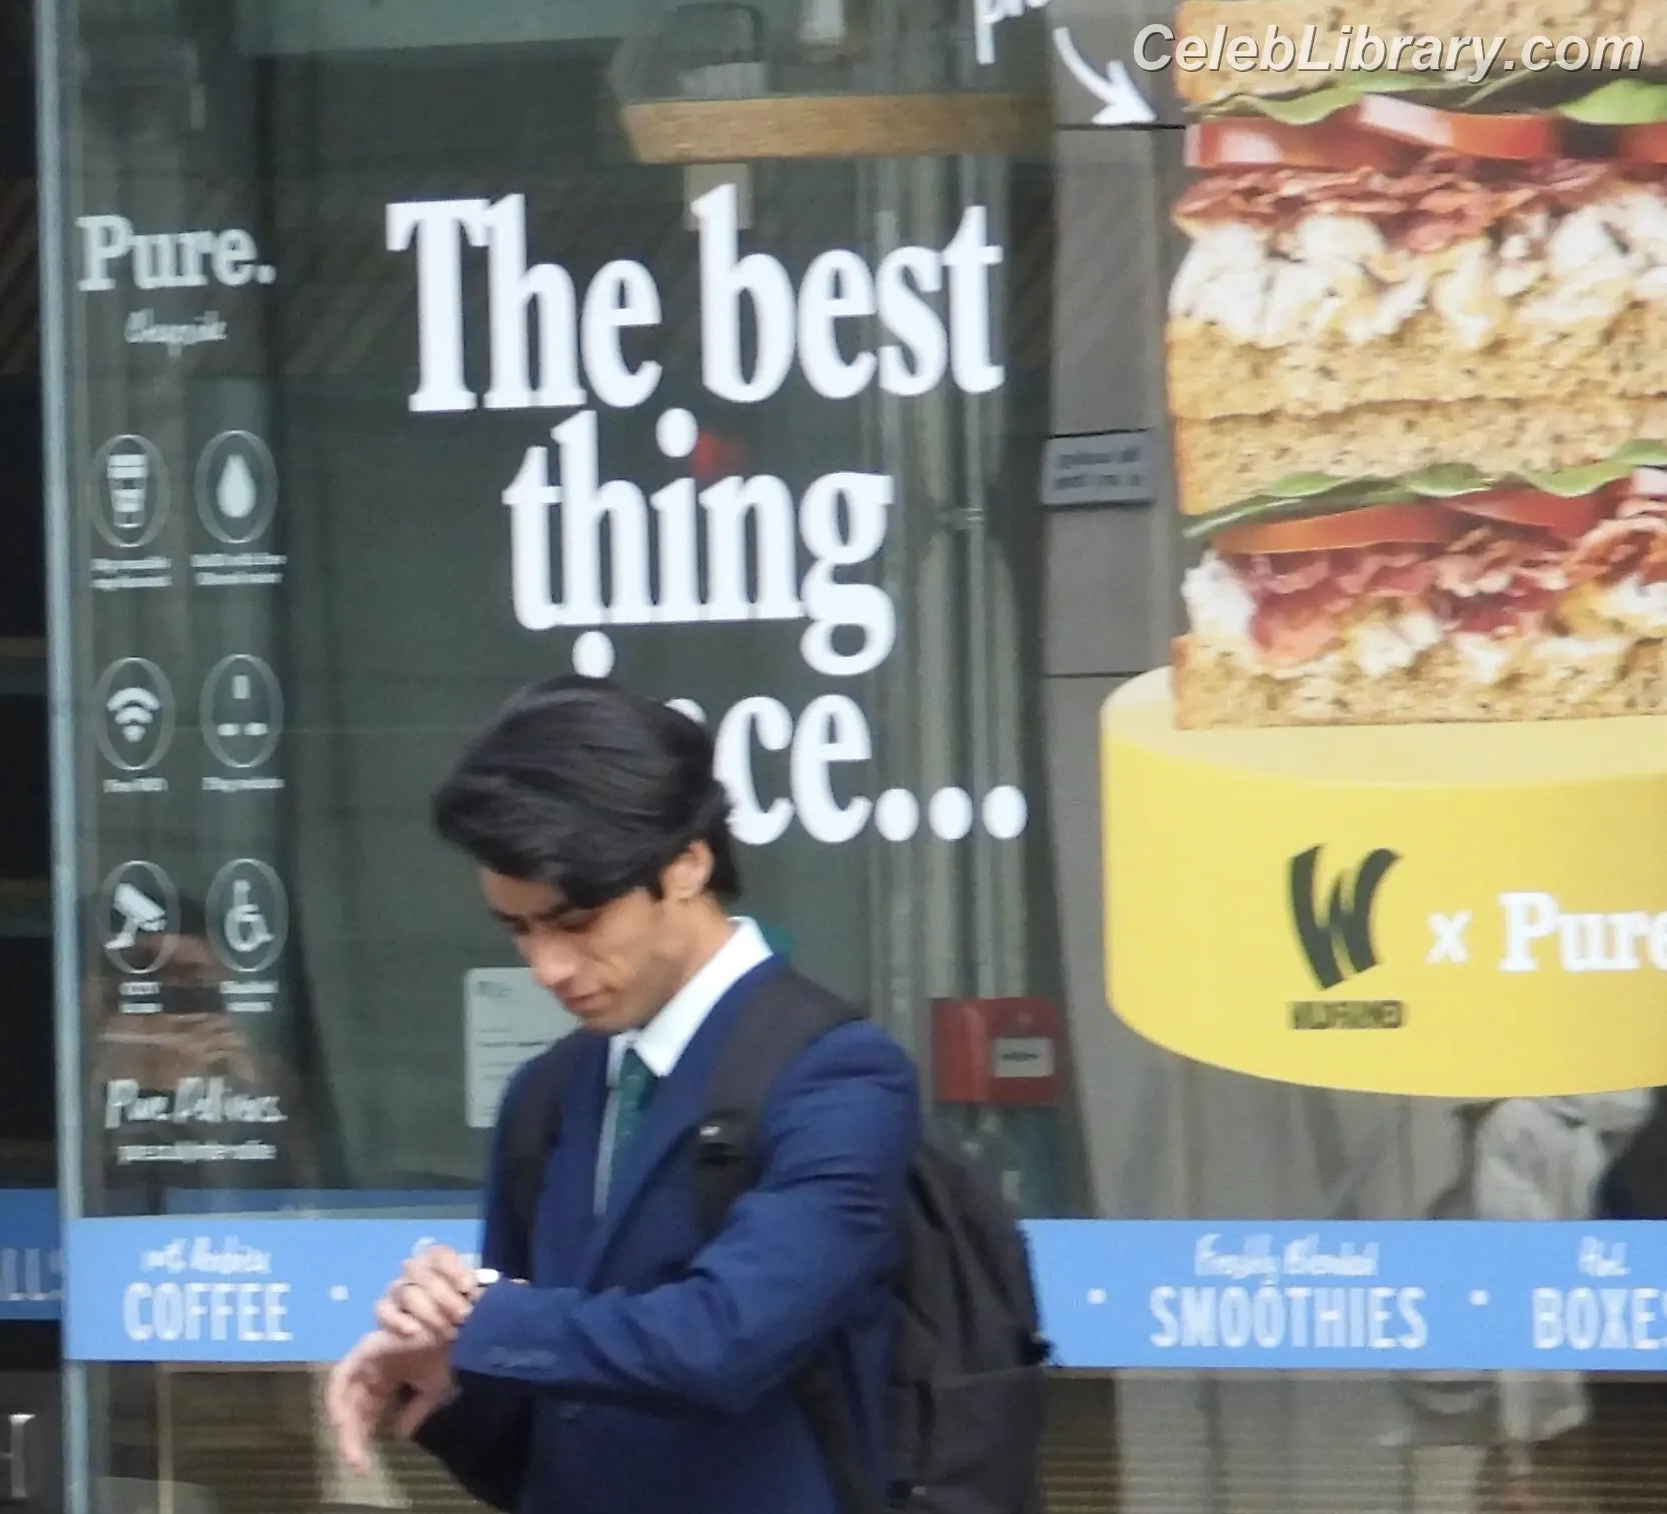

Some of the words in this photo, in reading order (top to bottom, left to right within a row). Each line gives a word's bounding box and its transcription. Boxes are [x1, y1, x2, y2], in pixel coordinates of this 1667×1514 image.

[74, 214, 276, 291] Pure.
[386, 193, 663, 411] The
[691, 183, 1005, 401] best
[502, 410, 896, 675] thing
[124, 1282, 292, 1341] COFFEE
[1149, 1286, 1428, 1349] SMOOTHIES
[1533, 1287, 1667, 1350] BOXE
